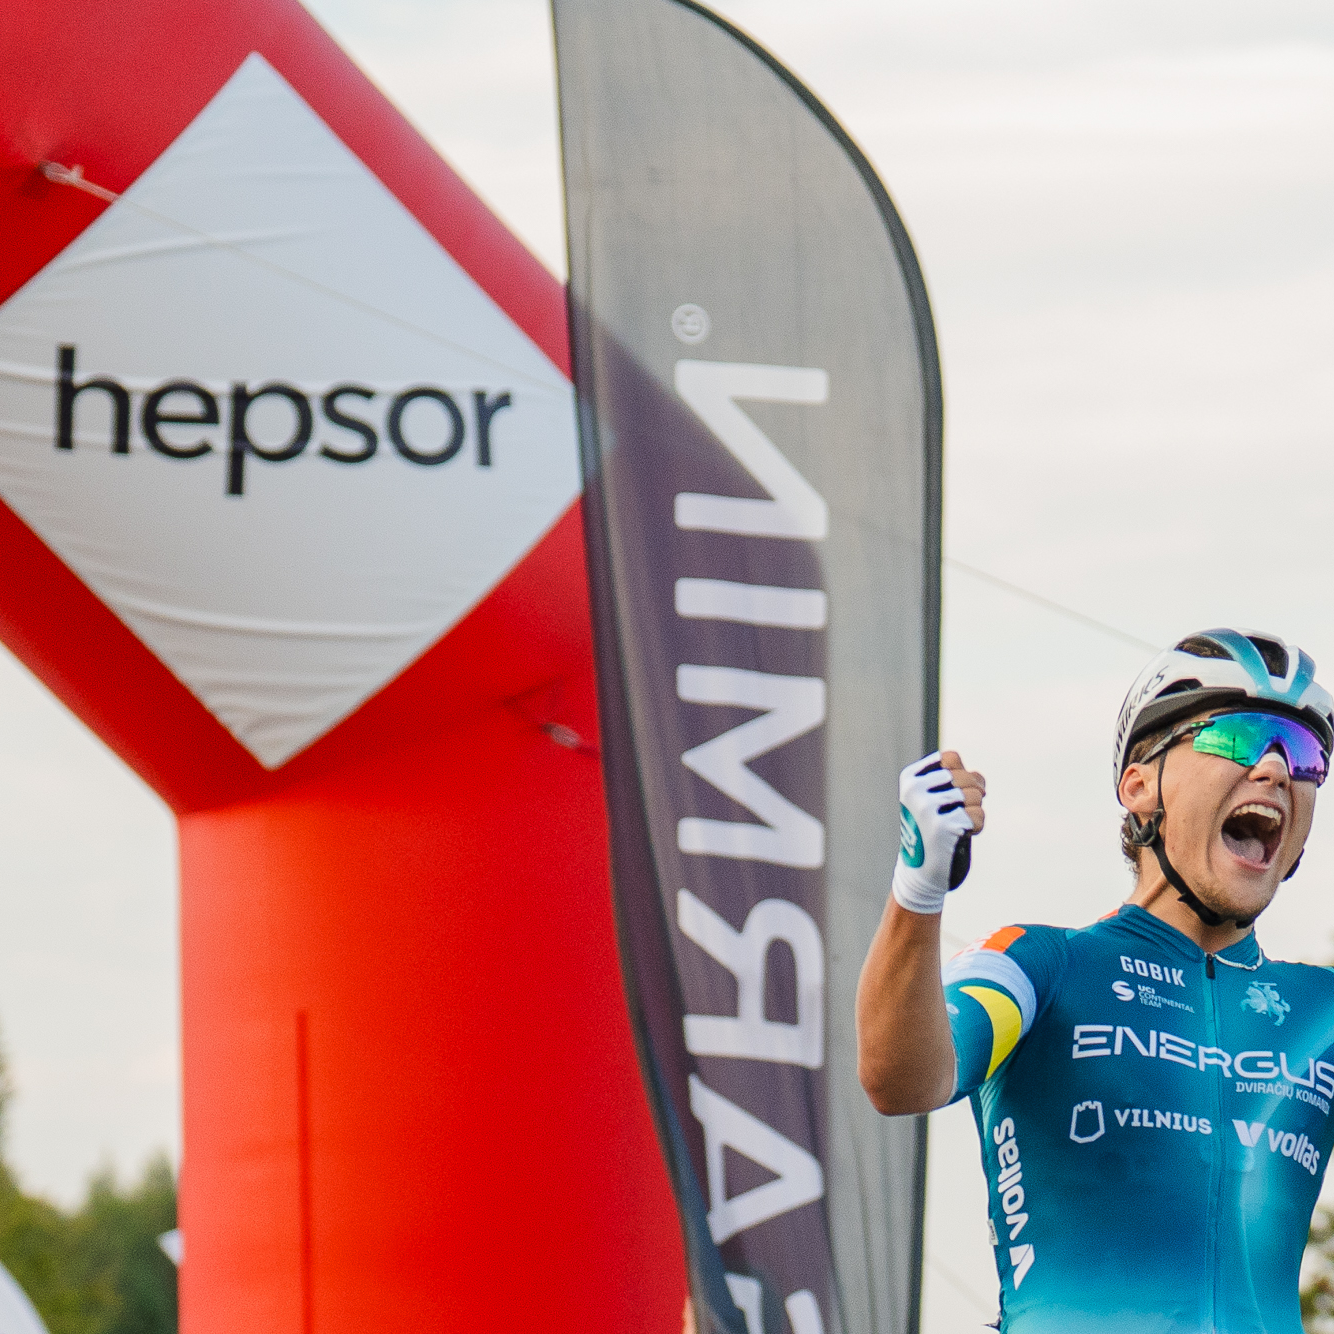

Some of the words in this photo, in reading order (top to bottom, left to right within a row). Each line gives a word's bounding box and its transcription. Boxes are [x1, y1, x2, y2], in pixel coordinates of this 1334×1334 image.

[54, 342, 512, 497] hepsor
[1119, 955, 1186, 988] GOBIK
[1137, 984, 1156, 995] UCI
[1138, 991, 1195, 1014] CONTINENTAL
[1140, 998, 1162, 1009] TEAM
[1235, 1081, 1294, 1100] DVIRAČIŲ
[1114, 1108, 1212, 1136] VILNIUS
[1267, 1127, 1320, 1176] voltas
[993, 1116, 1030, 1241] voltas
